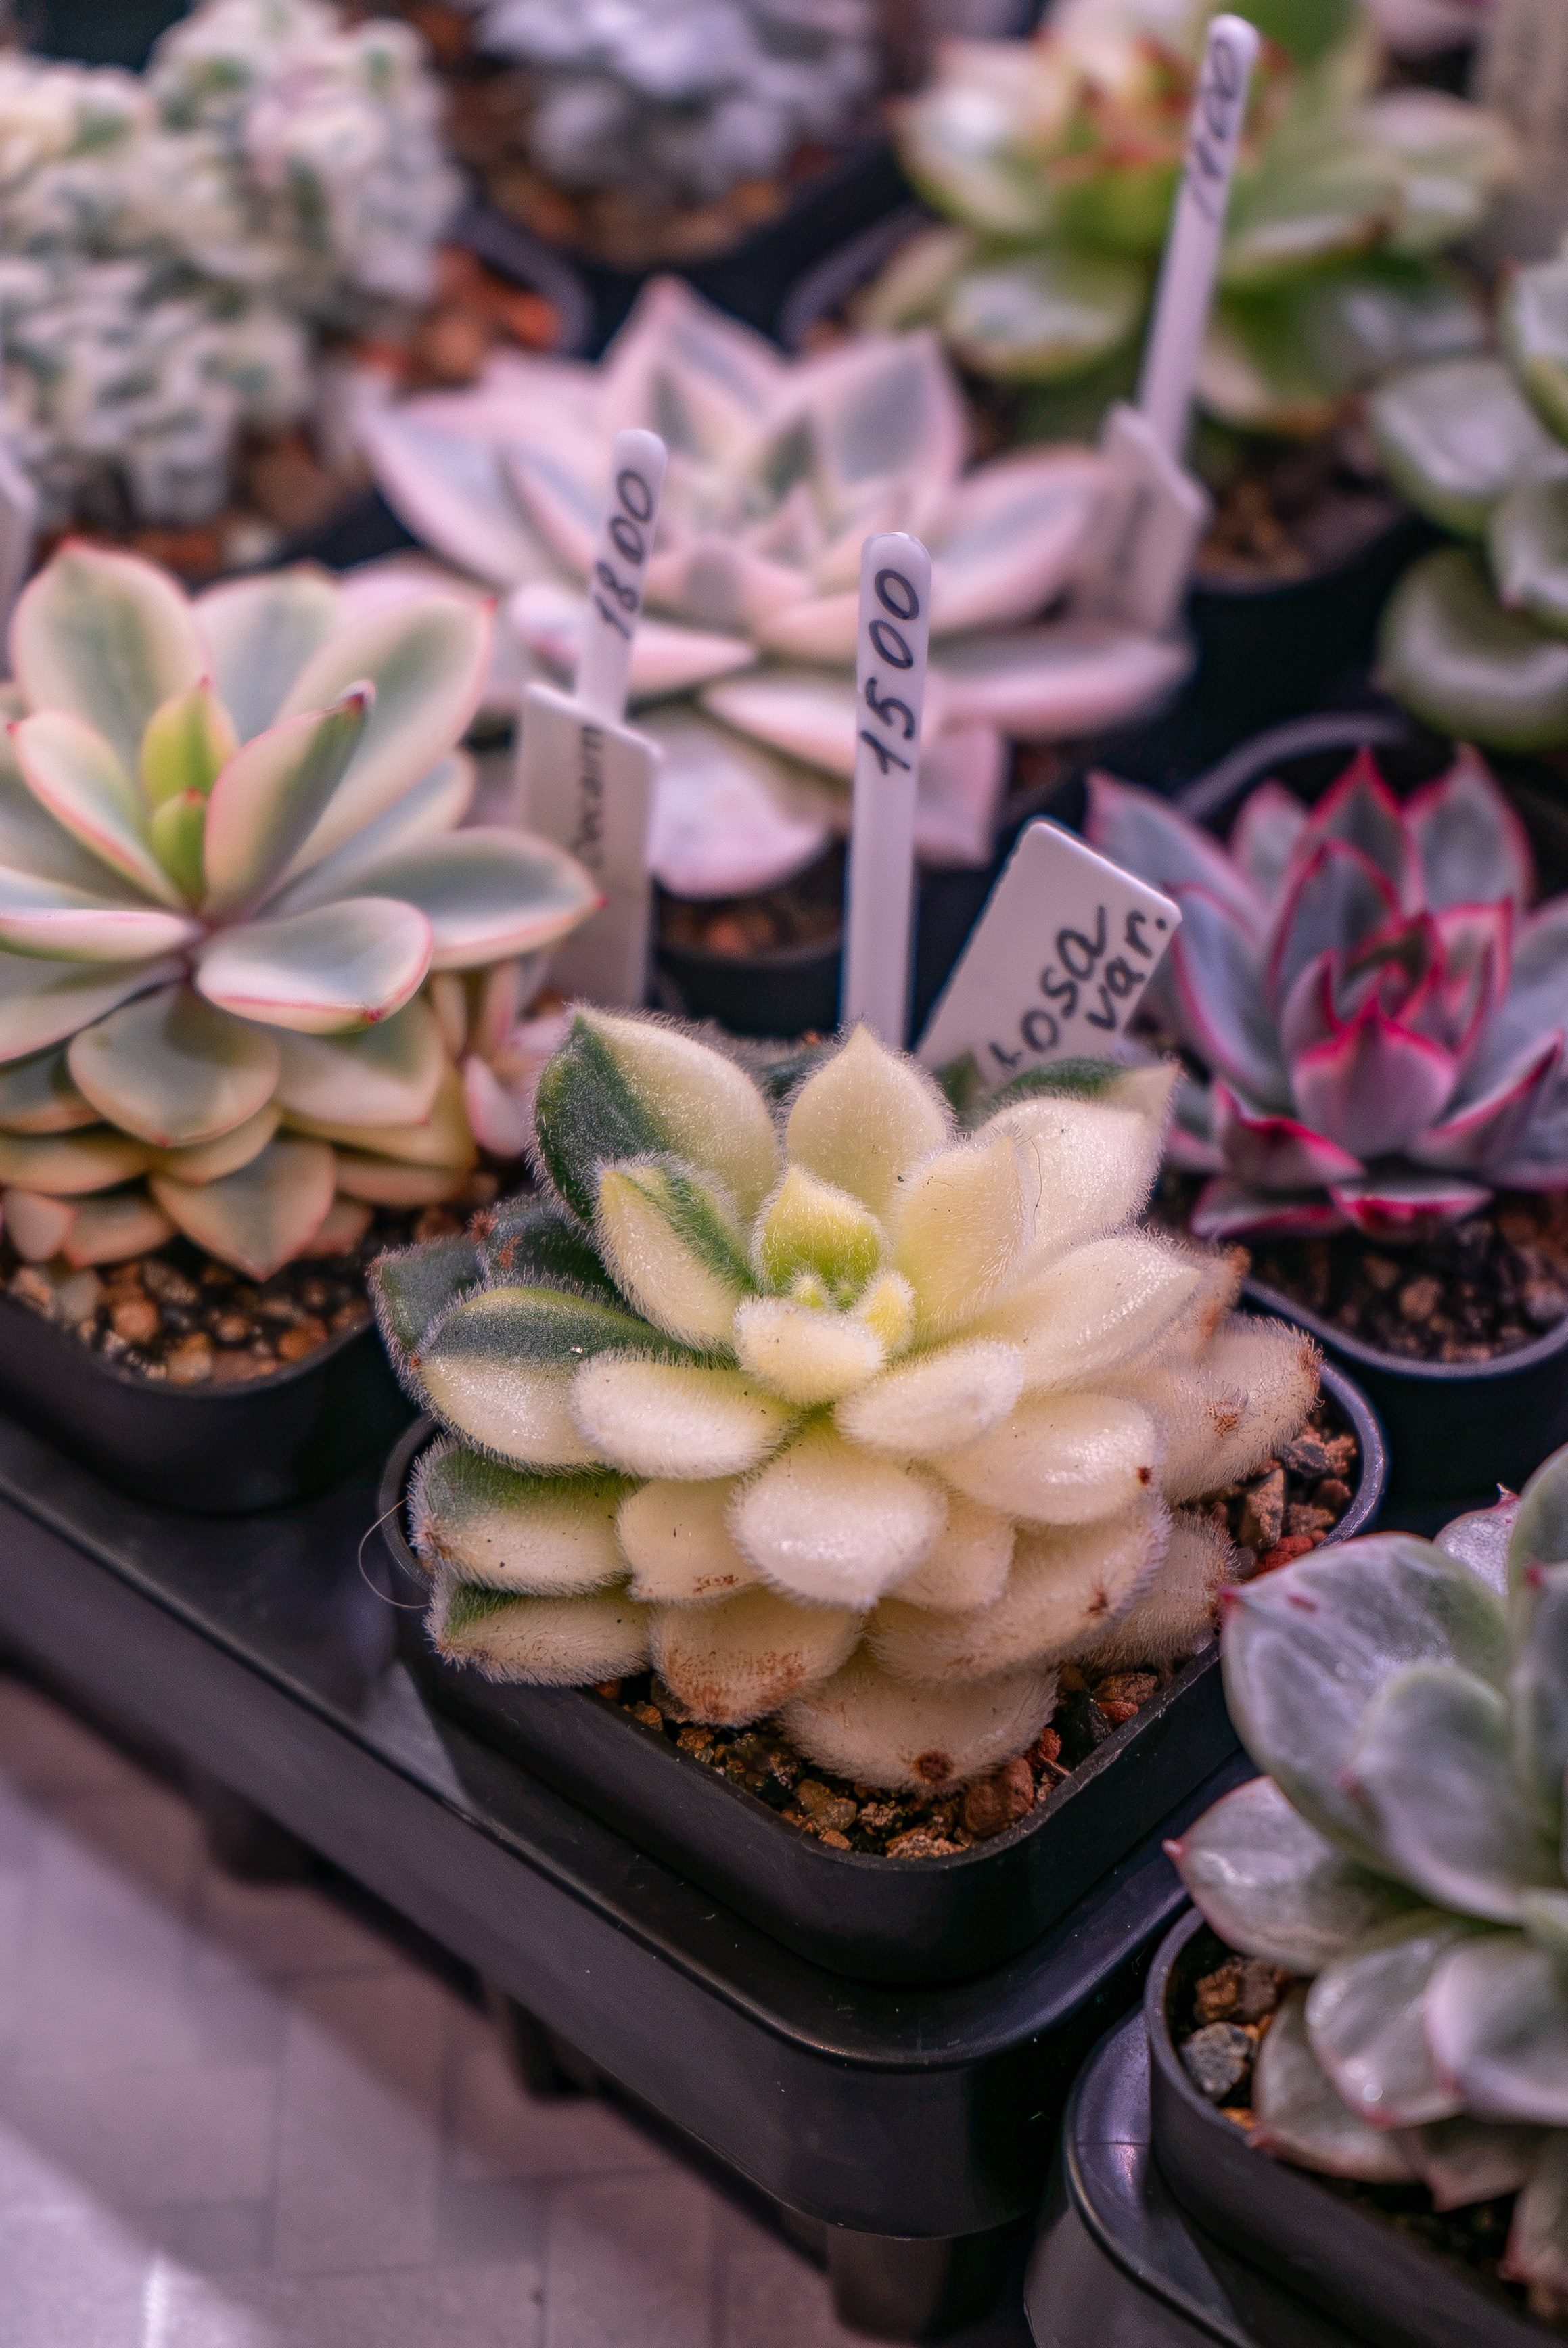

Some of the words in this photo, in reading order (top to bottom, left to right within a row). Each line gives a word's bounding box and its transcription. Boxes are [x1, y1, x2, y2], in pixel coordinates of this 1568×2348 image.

[593, 468, 653, 640] 1800
[860, 568, 920, 775] 1500
[1086, 909, 1168, 1030] var.
